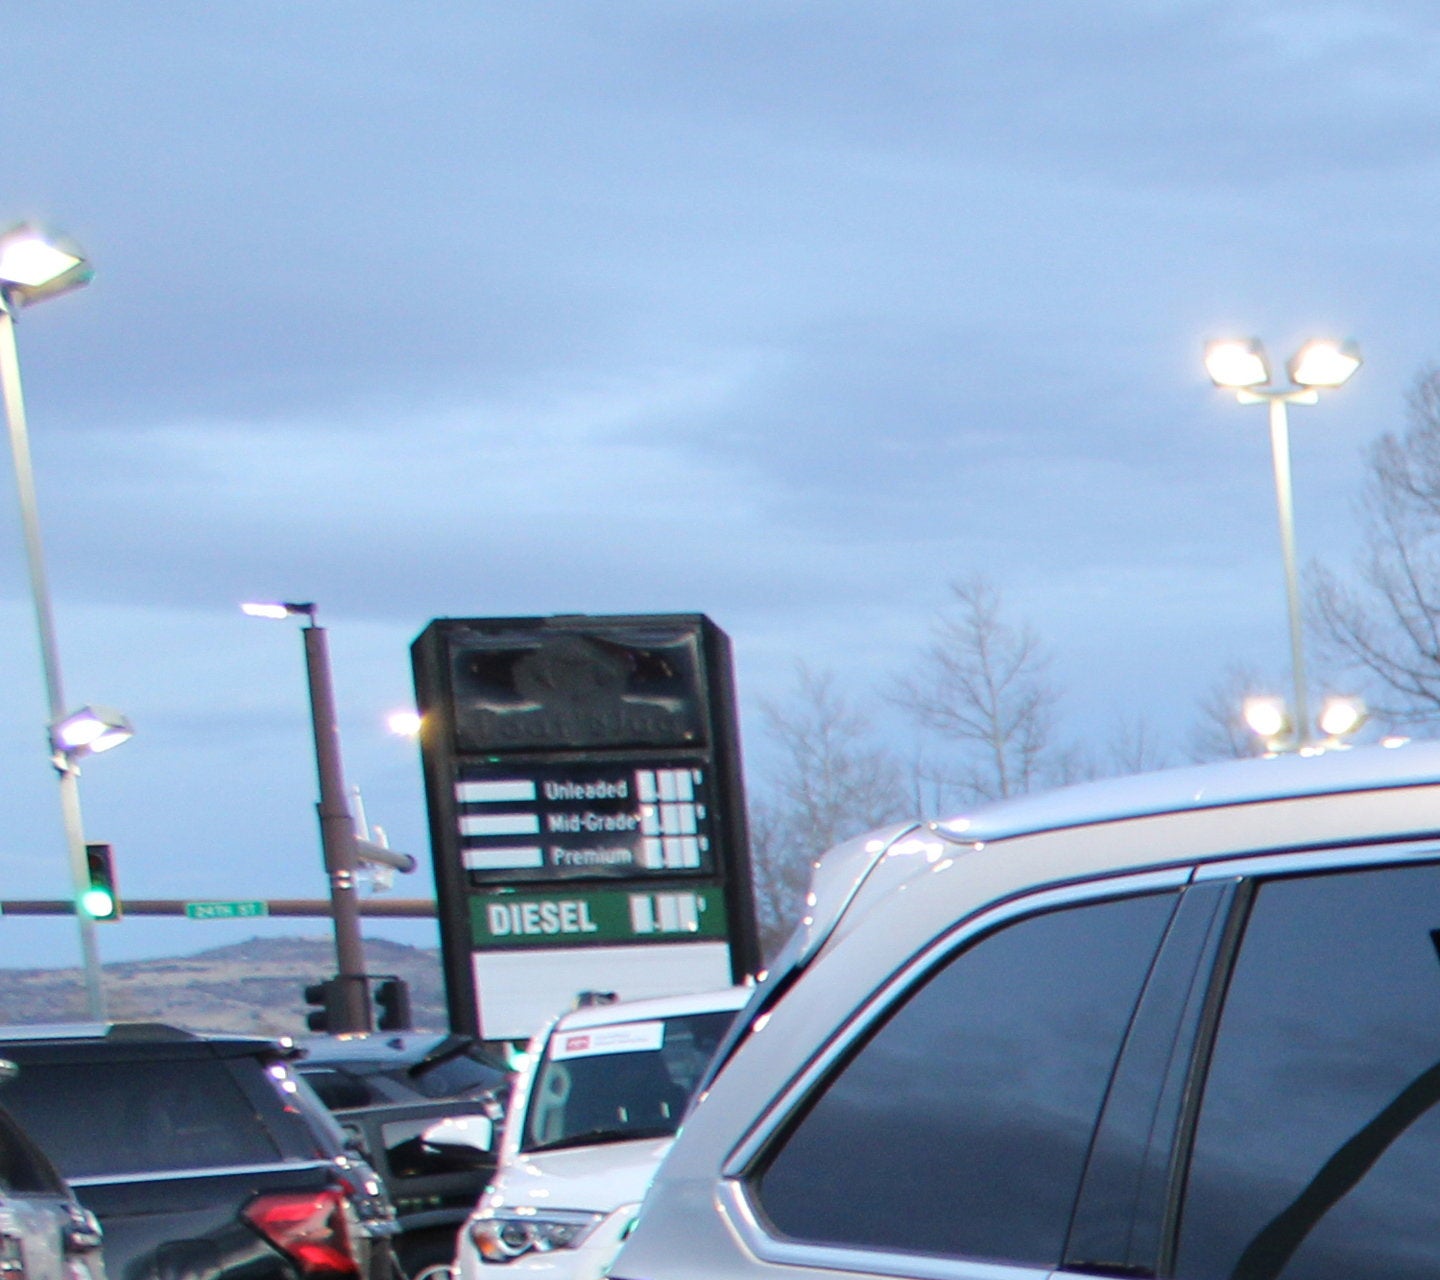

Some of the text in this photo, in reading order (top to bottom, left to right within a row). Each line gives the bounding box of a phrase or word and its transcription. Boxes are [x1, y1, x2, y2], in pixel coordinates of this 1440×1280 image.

[544, 779, 628, 801] Unleaded
[549, 812, 636, 833] Mid-Grade
[553, 846, 632, 866] Premium
[486, 900, 597, 936] DIESEL
